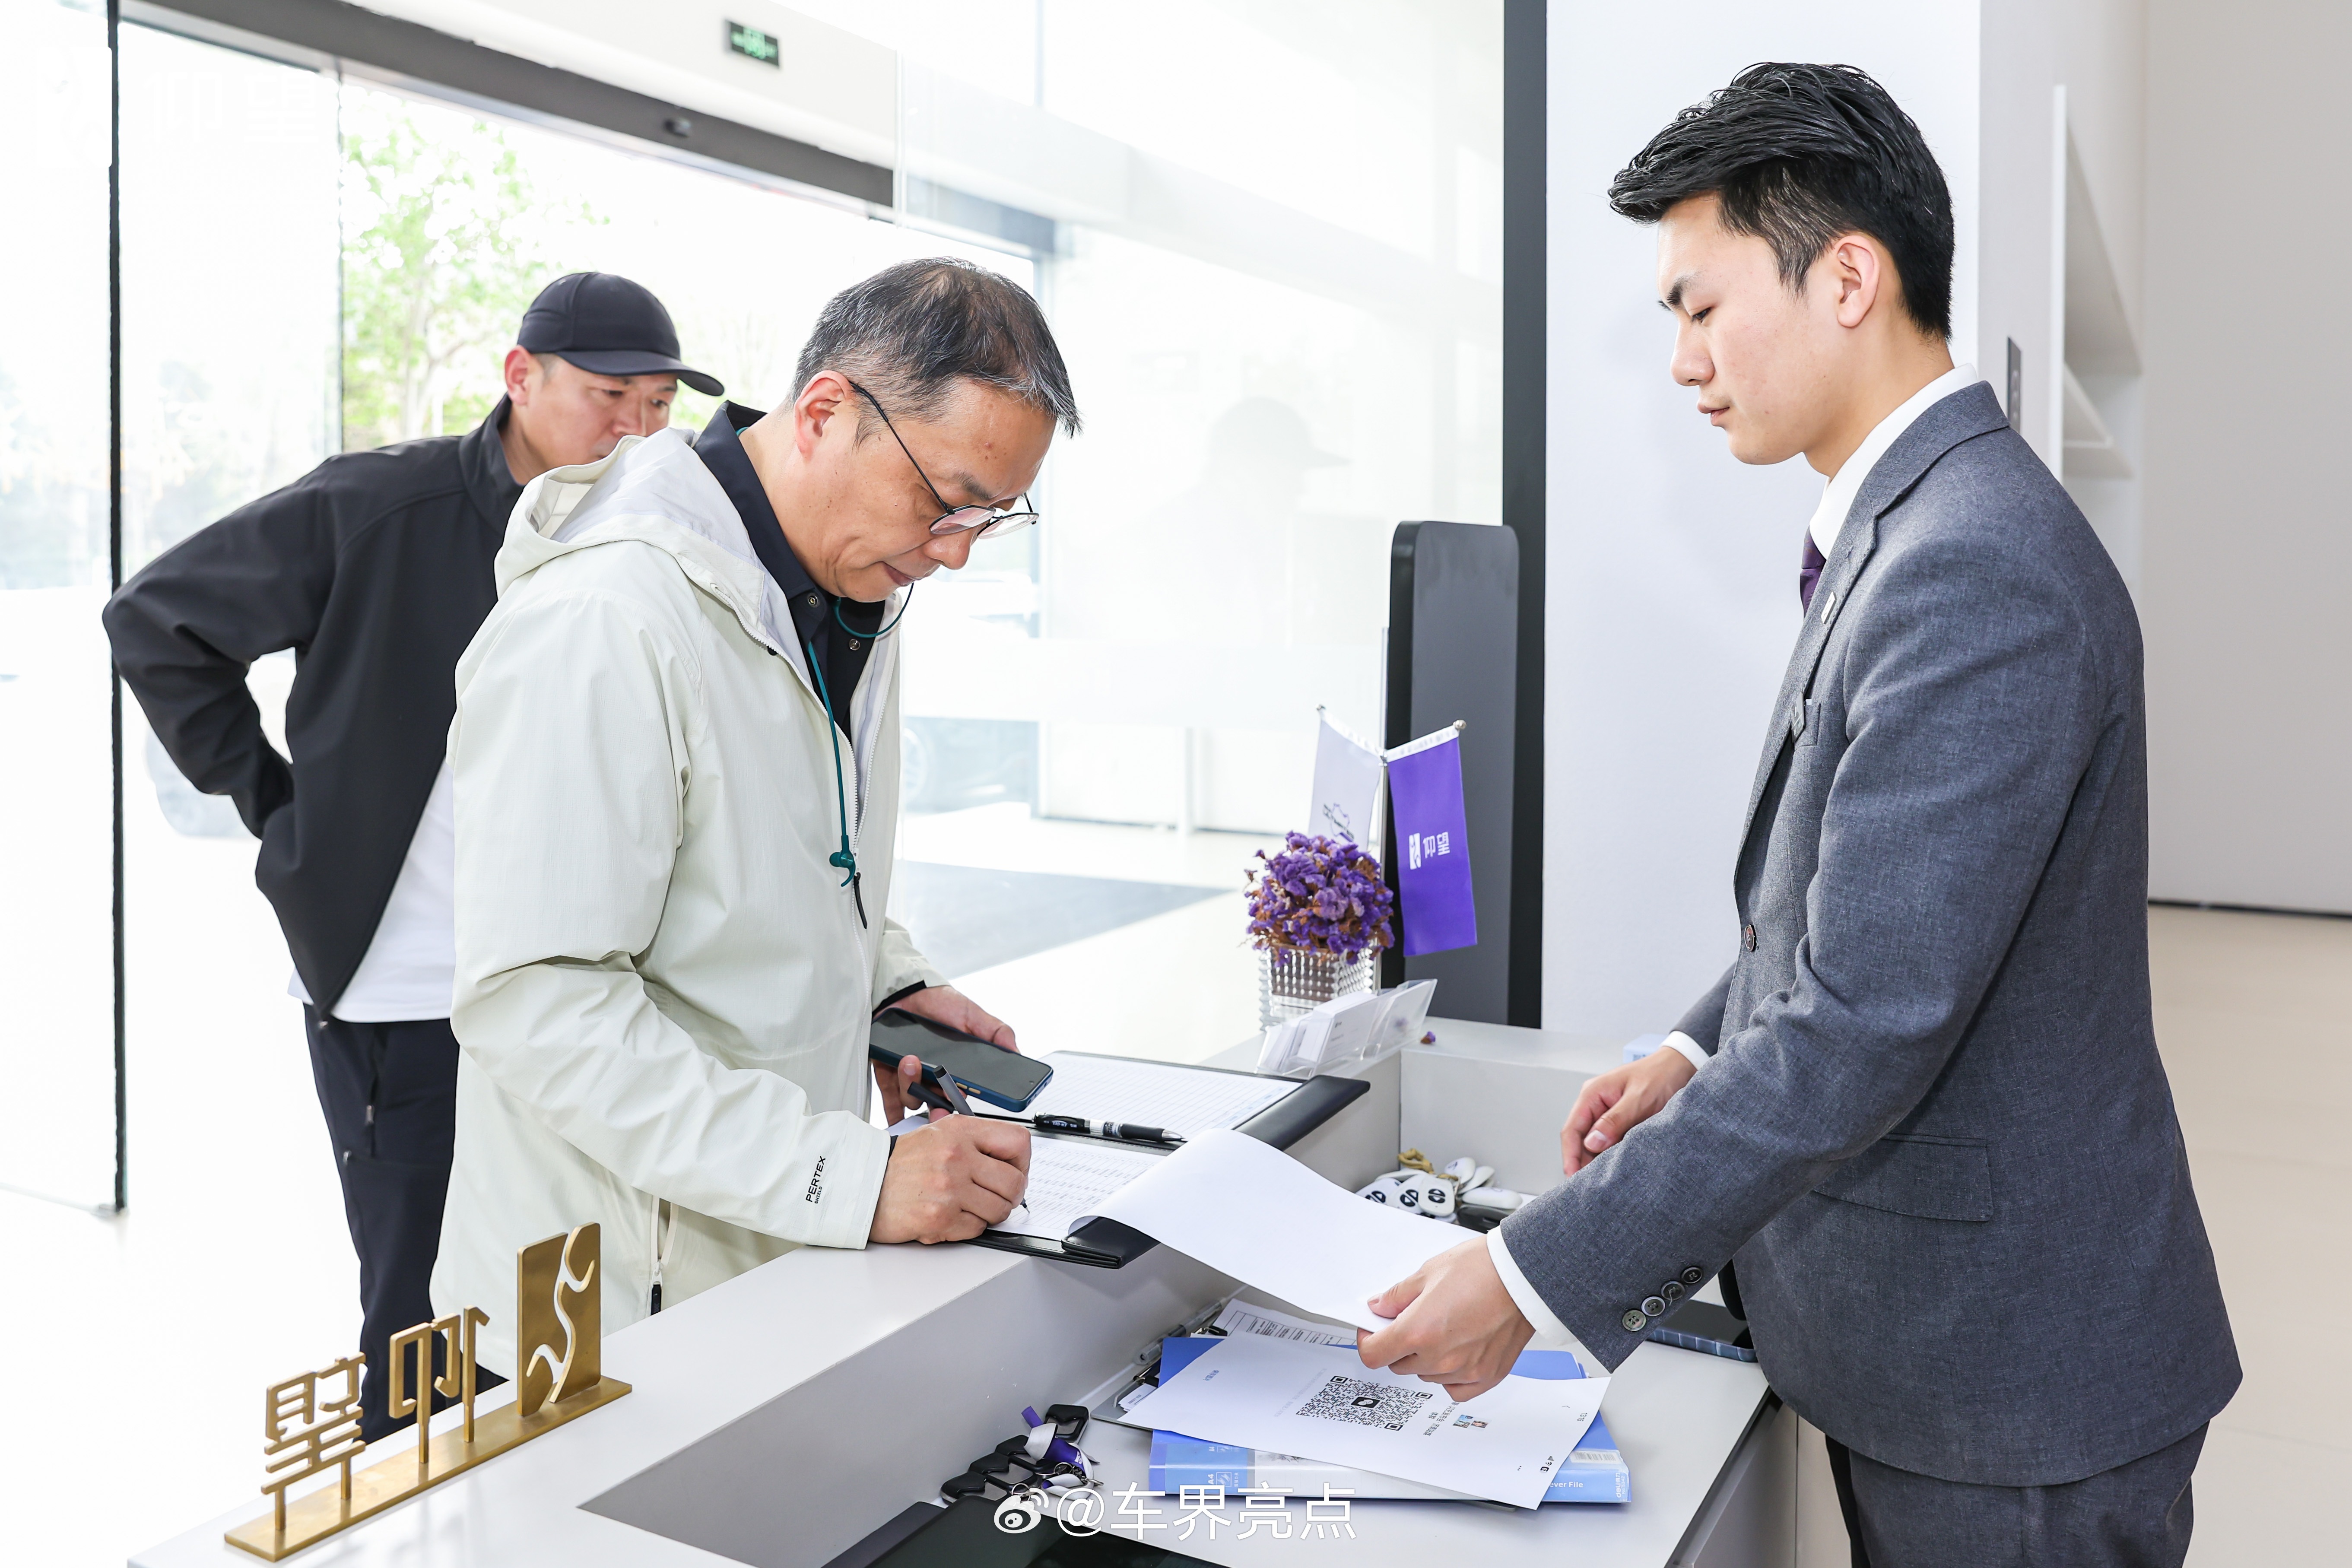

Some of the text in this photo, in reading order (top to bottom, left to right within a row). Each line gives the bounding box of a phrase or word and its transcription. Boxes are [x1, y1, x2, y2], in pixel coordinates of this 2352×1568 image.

[1422, 832, 1450, 858] 仰望
[806, 1155, 825, 1202] PERTEX
[814, 1186, 822, 1204] SHIELD
[1578, 1413, 1587, 1422] 13:15
[1208, 1473, 1214, 1485] A4
